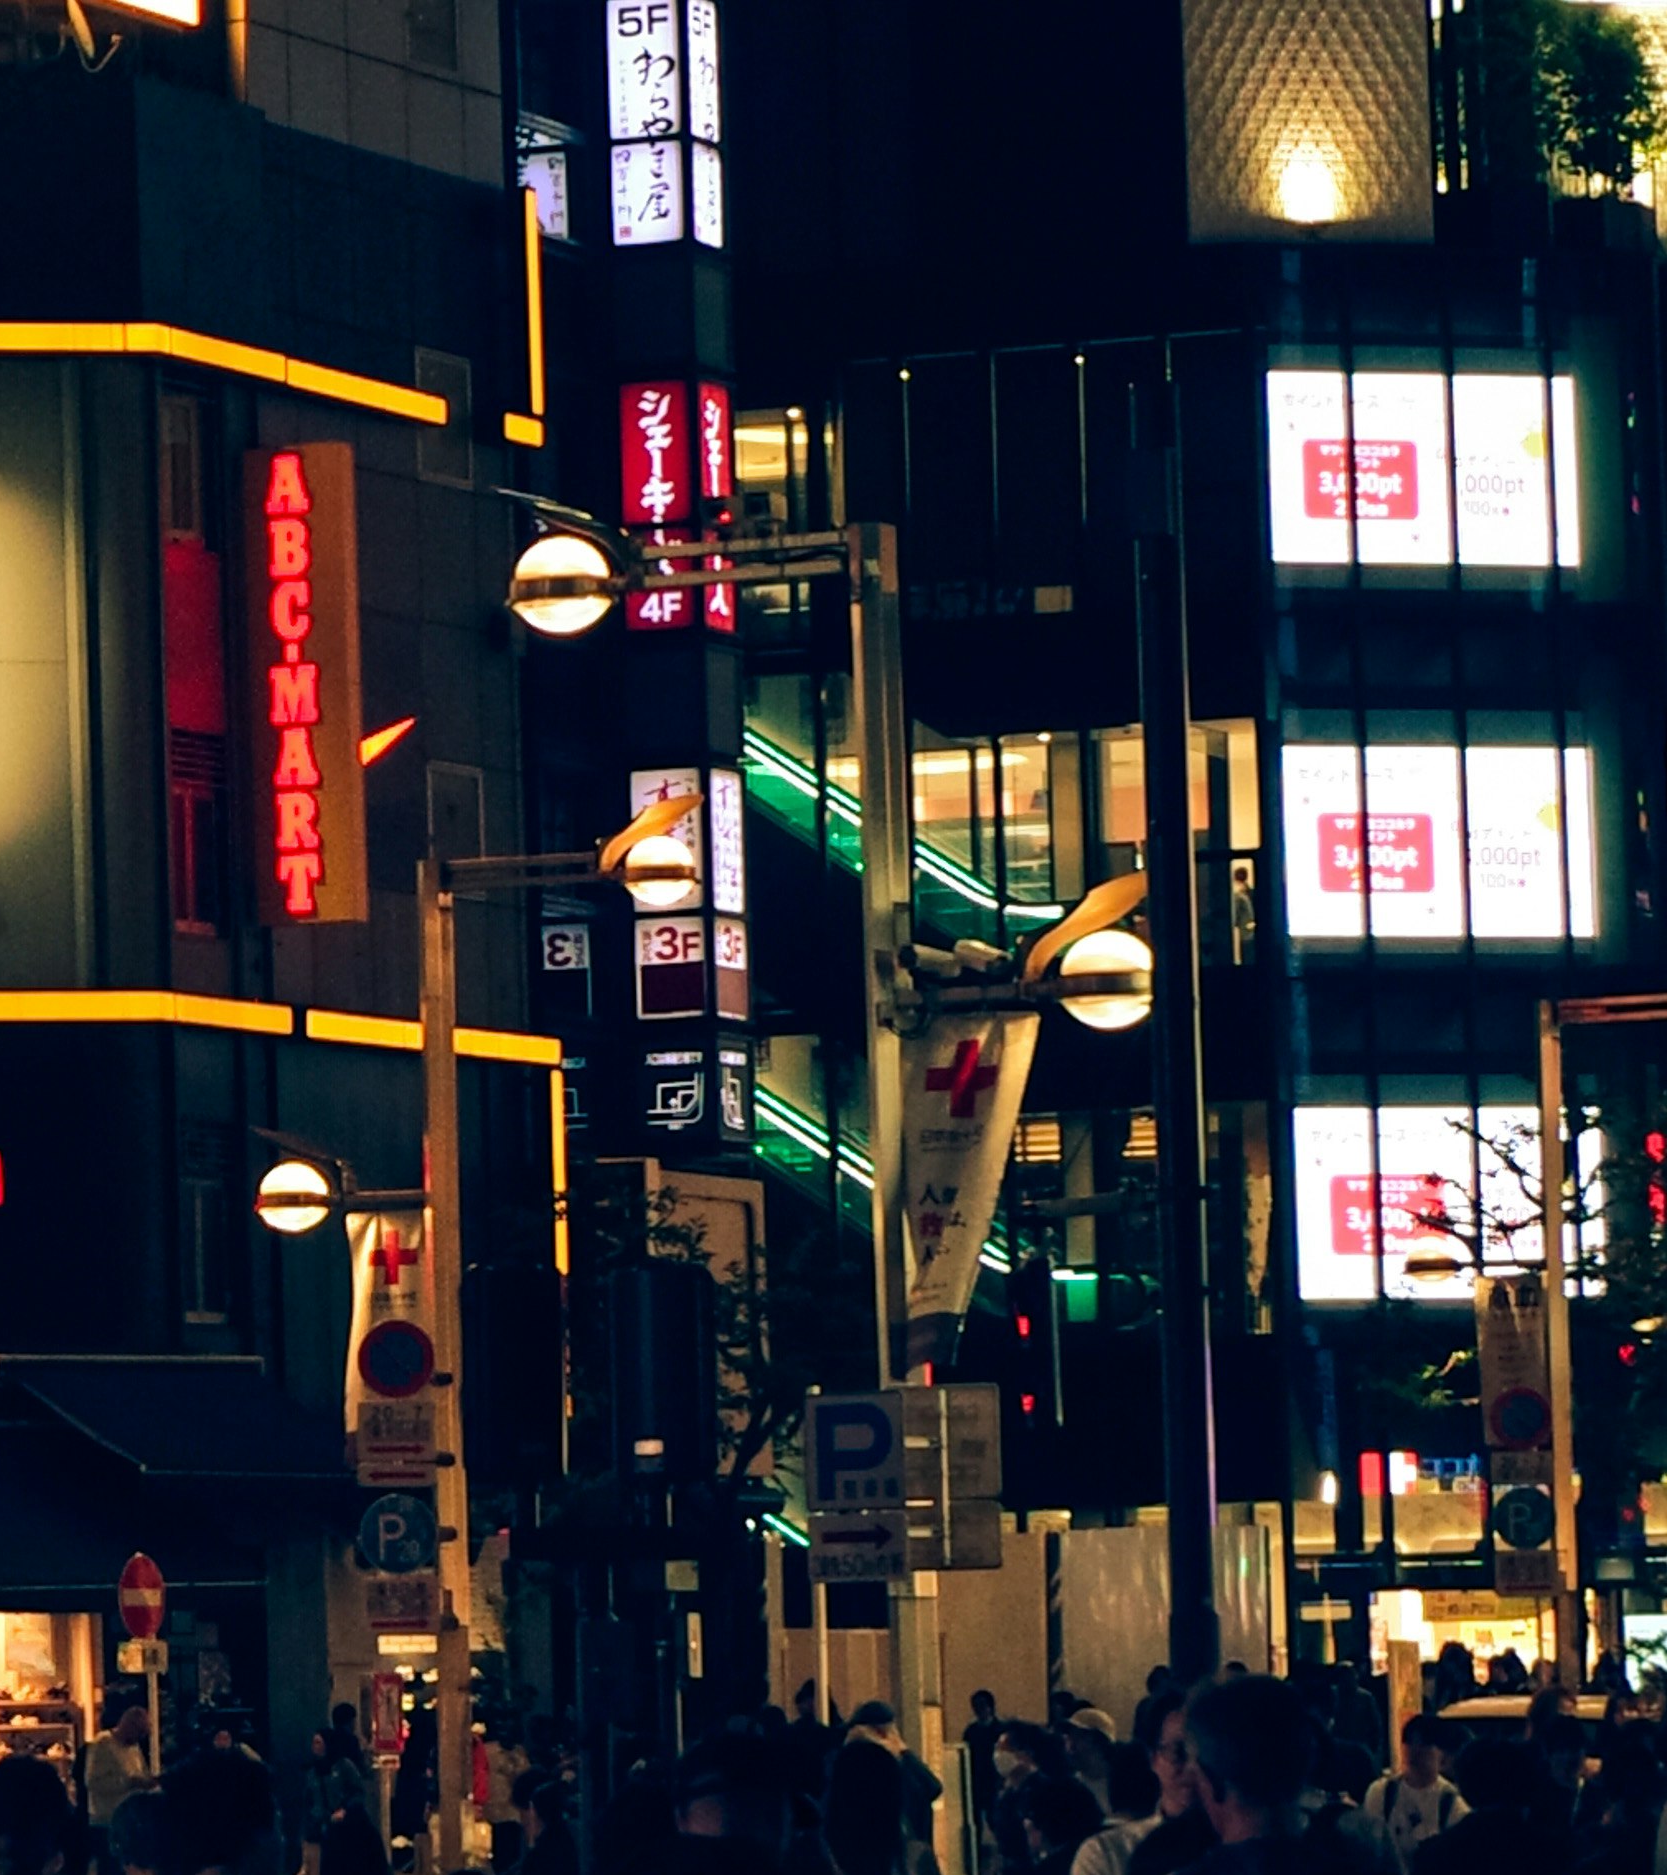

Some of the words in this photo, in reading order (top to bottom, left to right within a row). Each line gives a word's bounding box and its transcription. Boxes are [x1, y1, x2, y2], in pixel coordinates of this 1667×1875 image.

[618, 5, 668, 37] 5F
[639, 591, 683, 623] 4F
[265, 452, 323, 915] ABC-MART
[655, 926, 701, 961] 3F
[816, 1404, 893, 1500] P
[378, 1514, 407, 1561] P
